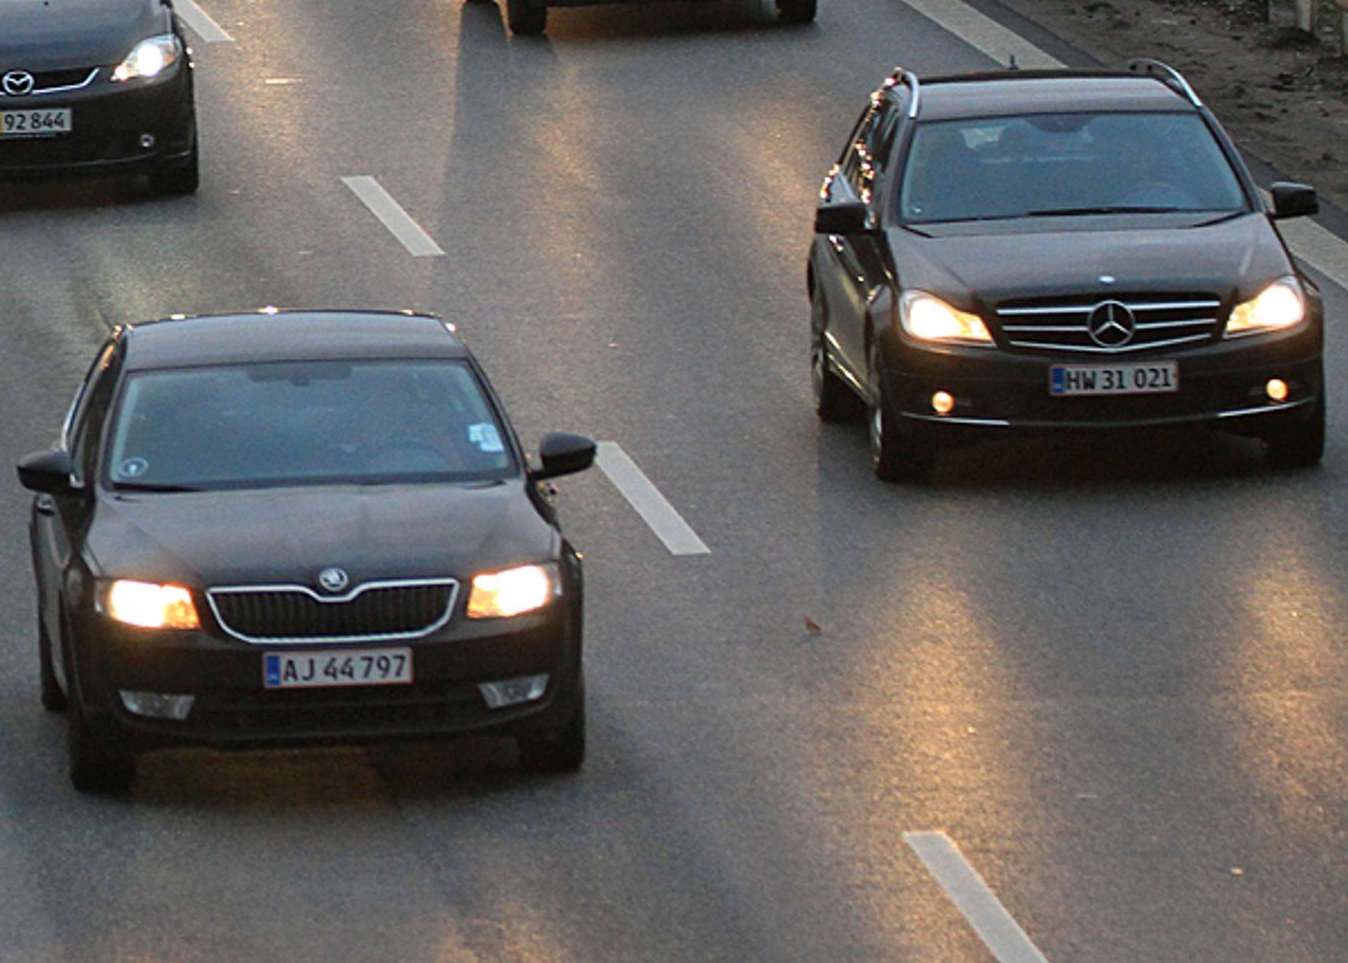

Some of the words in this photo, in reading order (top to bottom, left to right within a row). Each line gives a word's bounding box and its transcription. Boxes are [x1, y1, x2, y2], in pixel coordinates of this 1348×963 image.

[4, 114, 26, 131] 92
[30, 112, 65, 129] 844
[1066, 370, 1097, 390] HW
[1102, 370, 1127, 390] 31
[1134, 367, 1172, 389] 021
[283, 658, 315, 682] AJ
[323, 657, 355, 680] 44
[360, 655, 406, 679] 797
